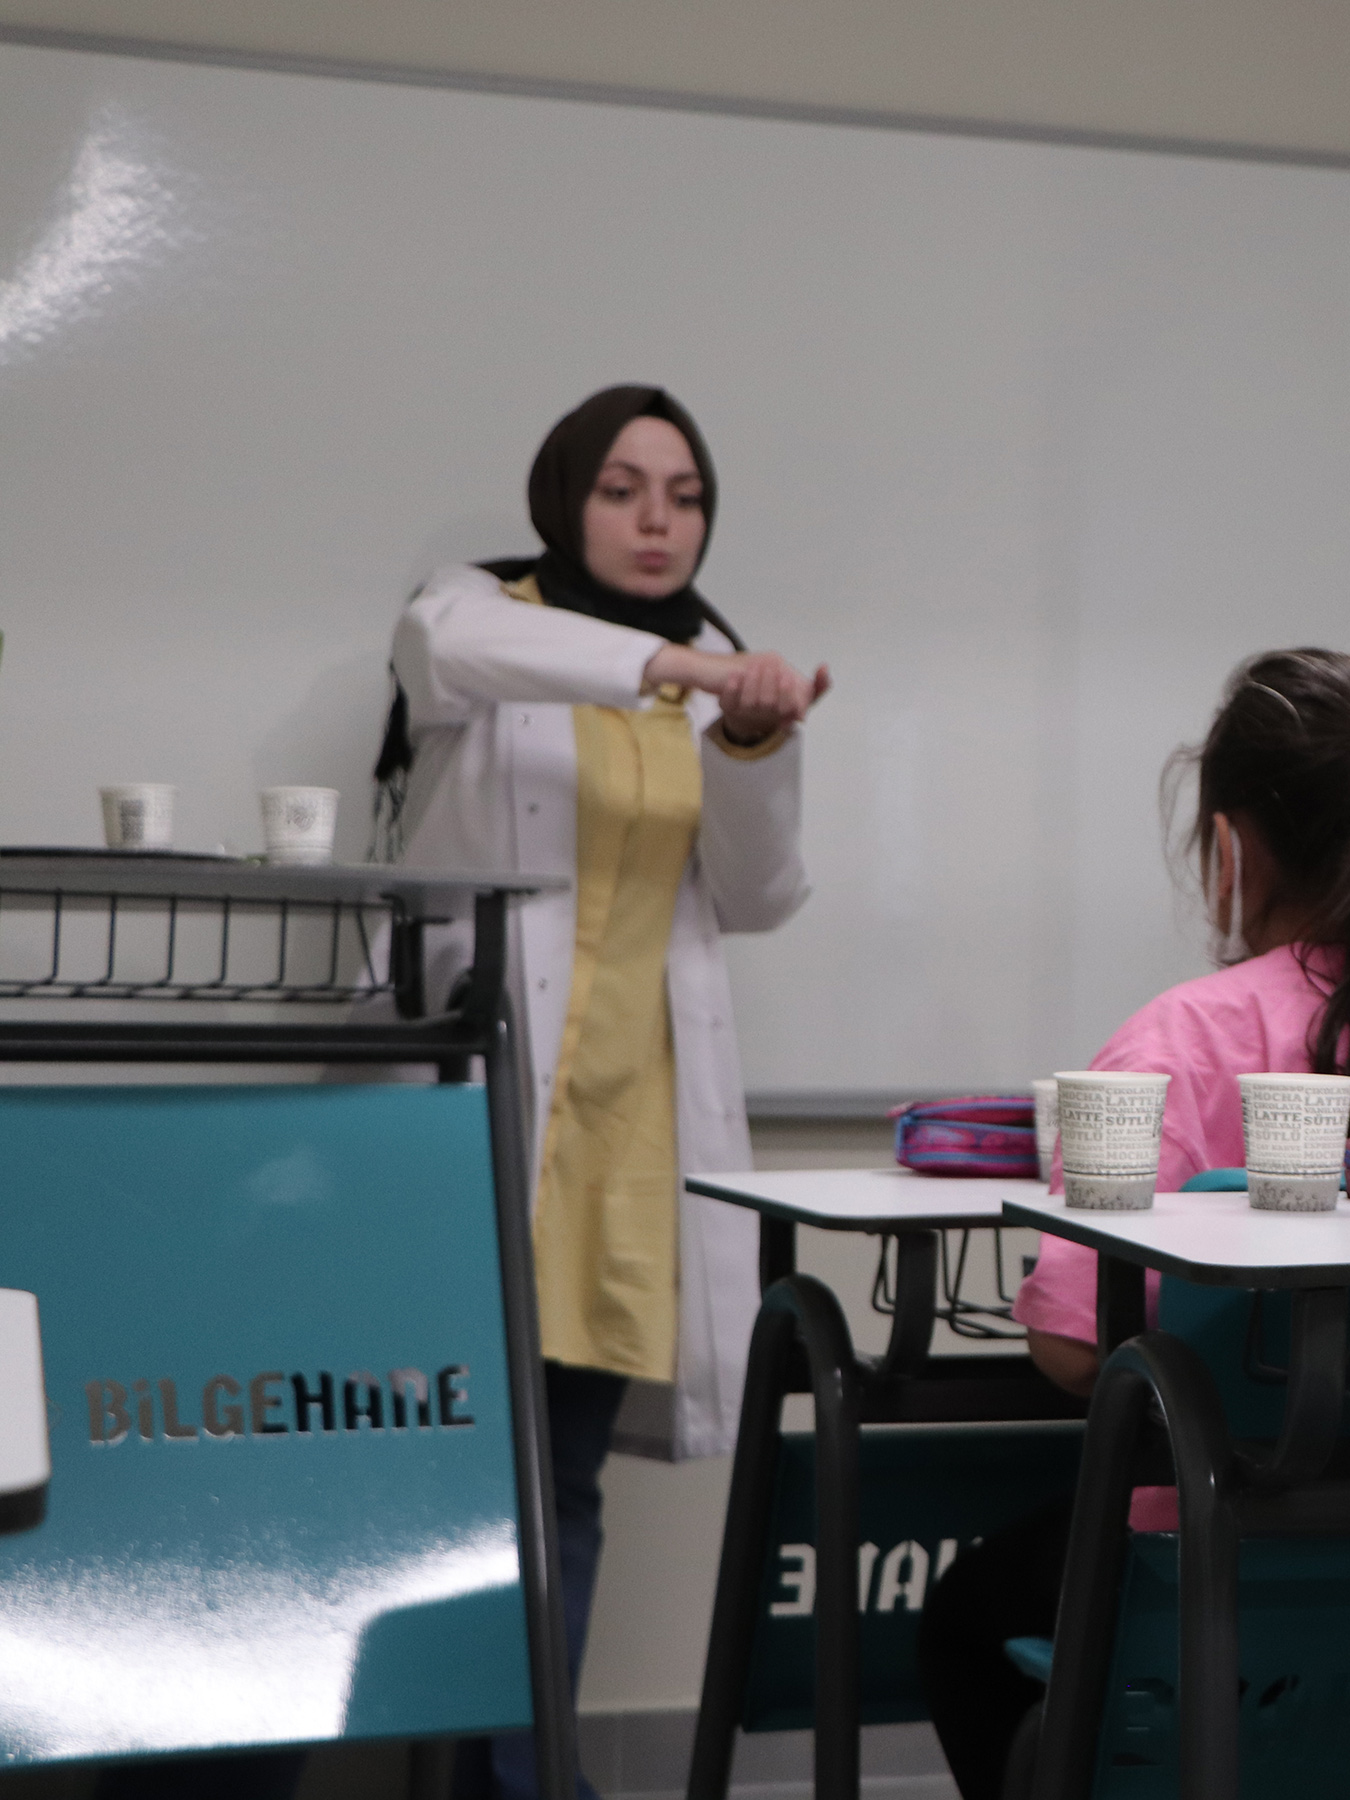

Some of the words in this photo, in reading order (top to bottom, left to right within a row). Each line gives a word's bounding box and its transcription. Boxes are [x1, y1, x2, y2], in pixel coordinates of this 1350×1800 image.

[1106, 1096, 1153, 1106] LATTE
[1253, 1091, 1303, 1103] MOCHA
[1063, 1109, 1104, 1122] LATTE
[1106, 1113, 1153, 1126] SÜTLÜ
[1255, 1110, 1303, 1122] LATTE
[1256, 1128, 1301, 1142] SÜTLÜ
